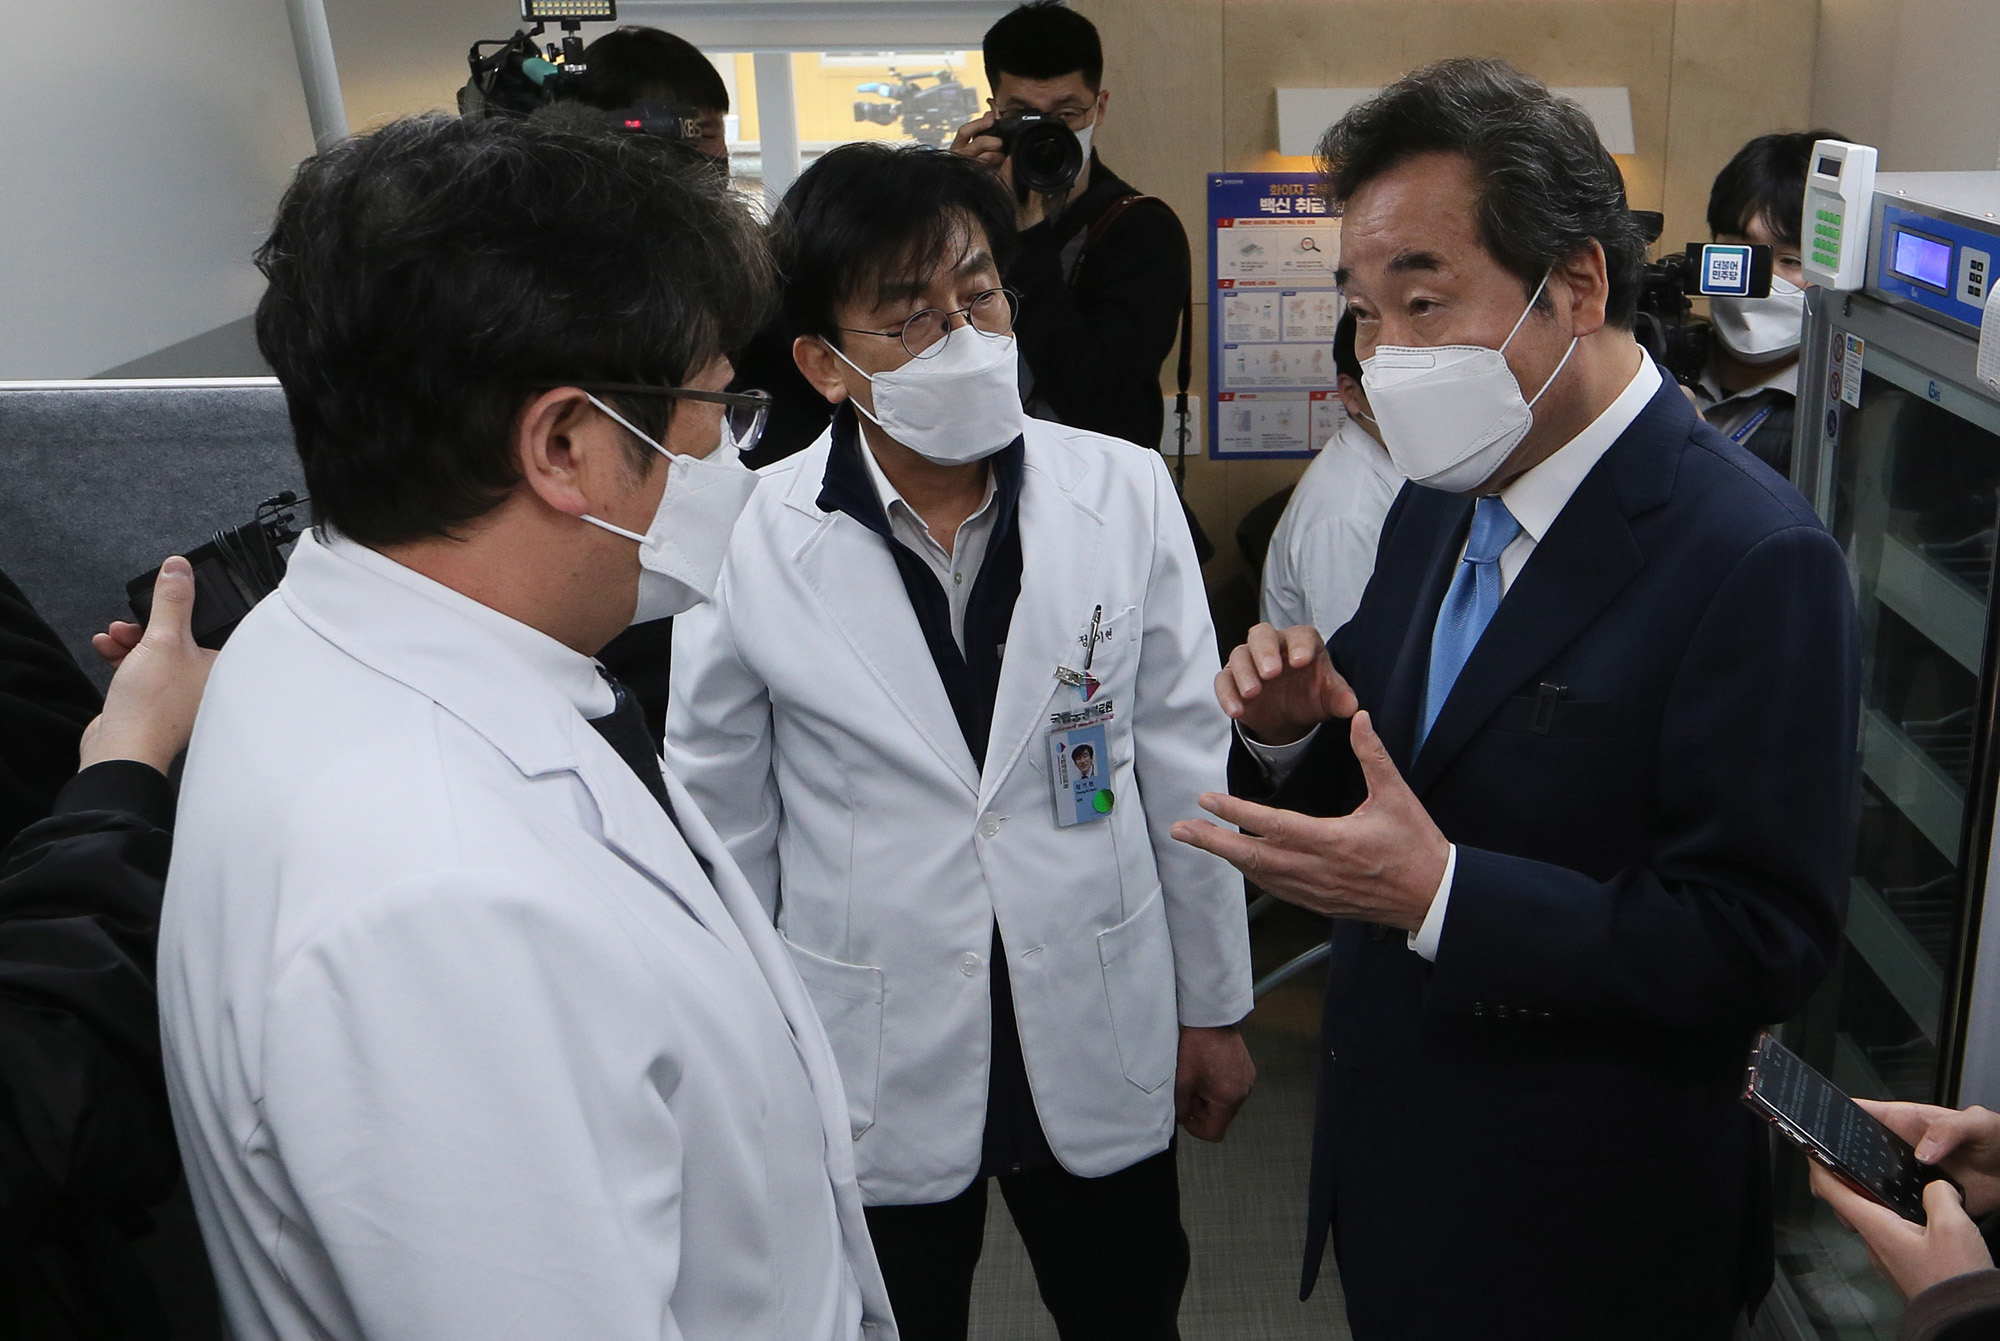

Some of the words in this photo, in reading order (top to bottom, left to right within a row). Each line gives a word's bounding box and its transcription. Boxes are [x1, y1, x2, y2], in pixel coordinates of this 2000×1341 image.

[681, 119, 702, 139] KBS
[1269, 183, 1304, 196] 화이자
[1259, 197, 1291, 214] 백신
[1294, 197, 1327, 214] 취급
[1712, 260, 1739, 271] 더불어
[1712, 270, 1738, 281] 민주당
